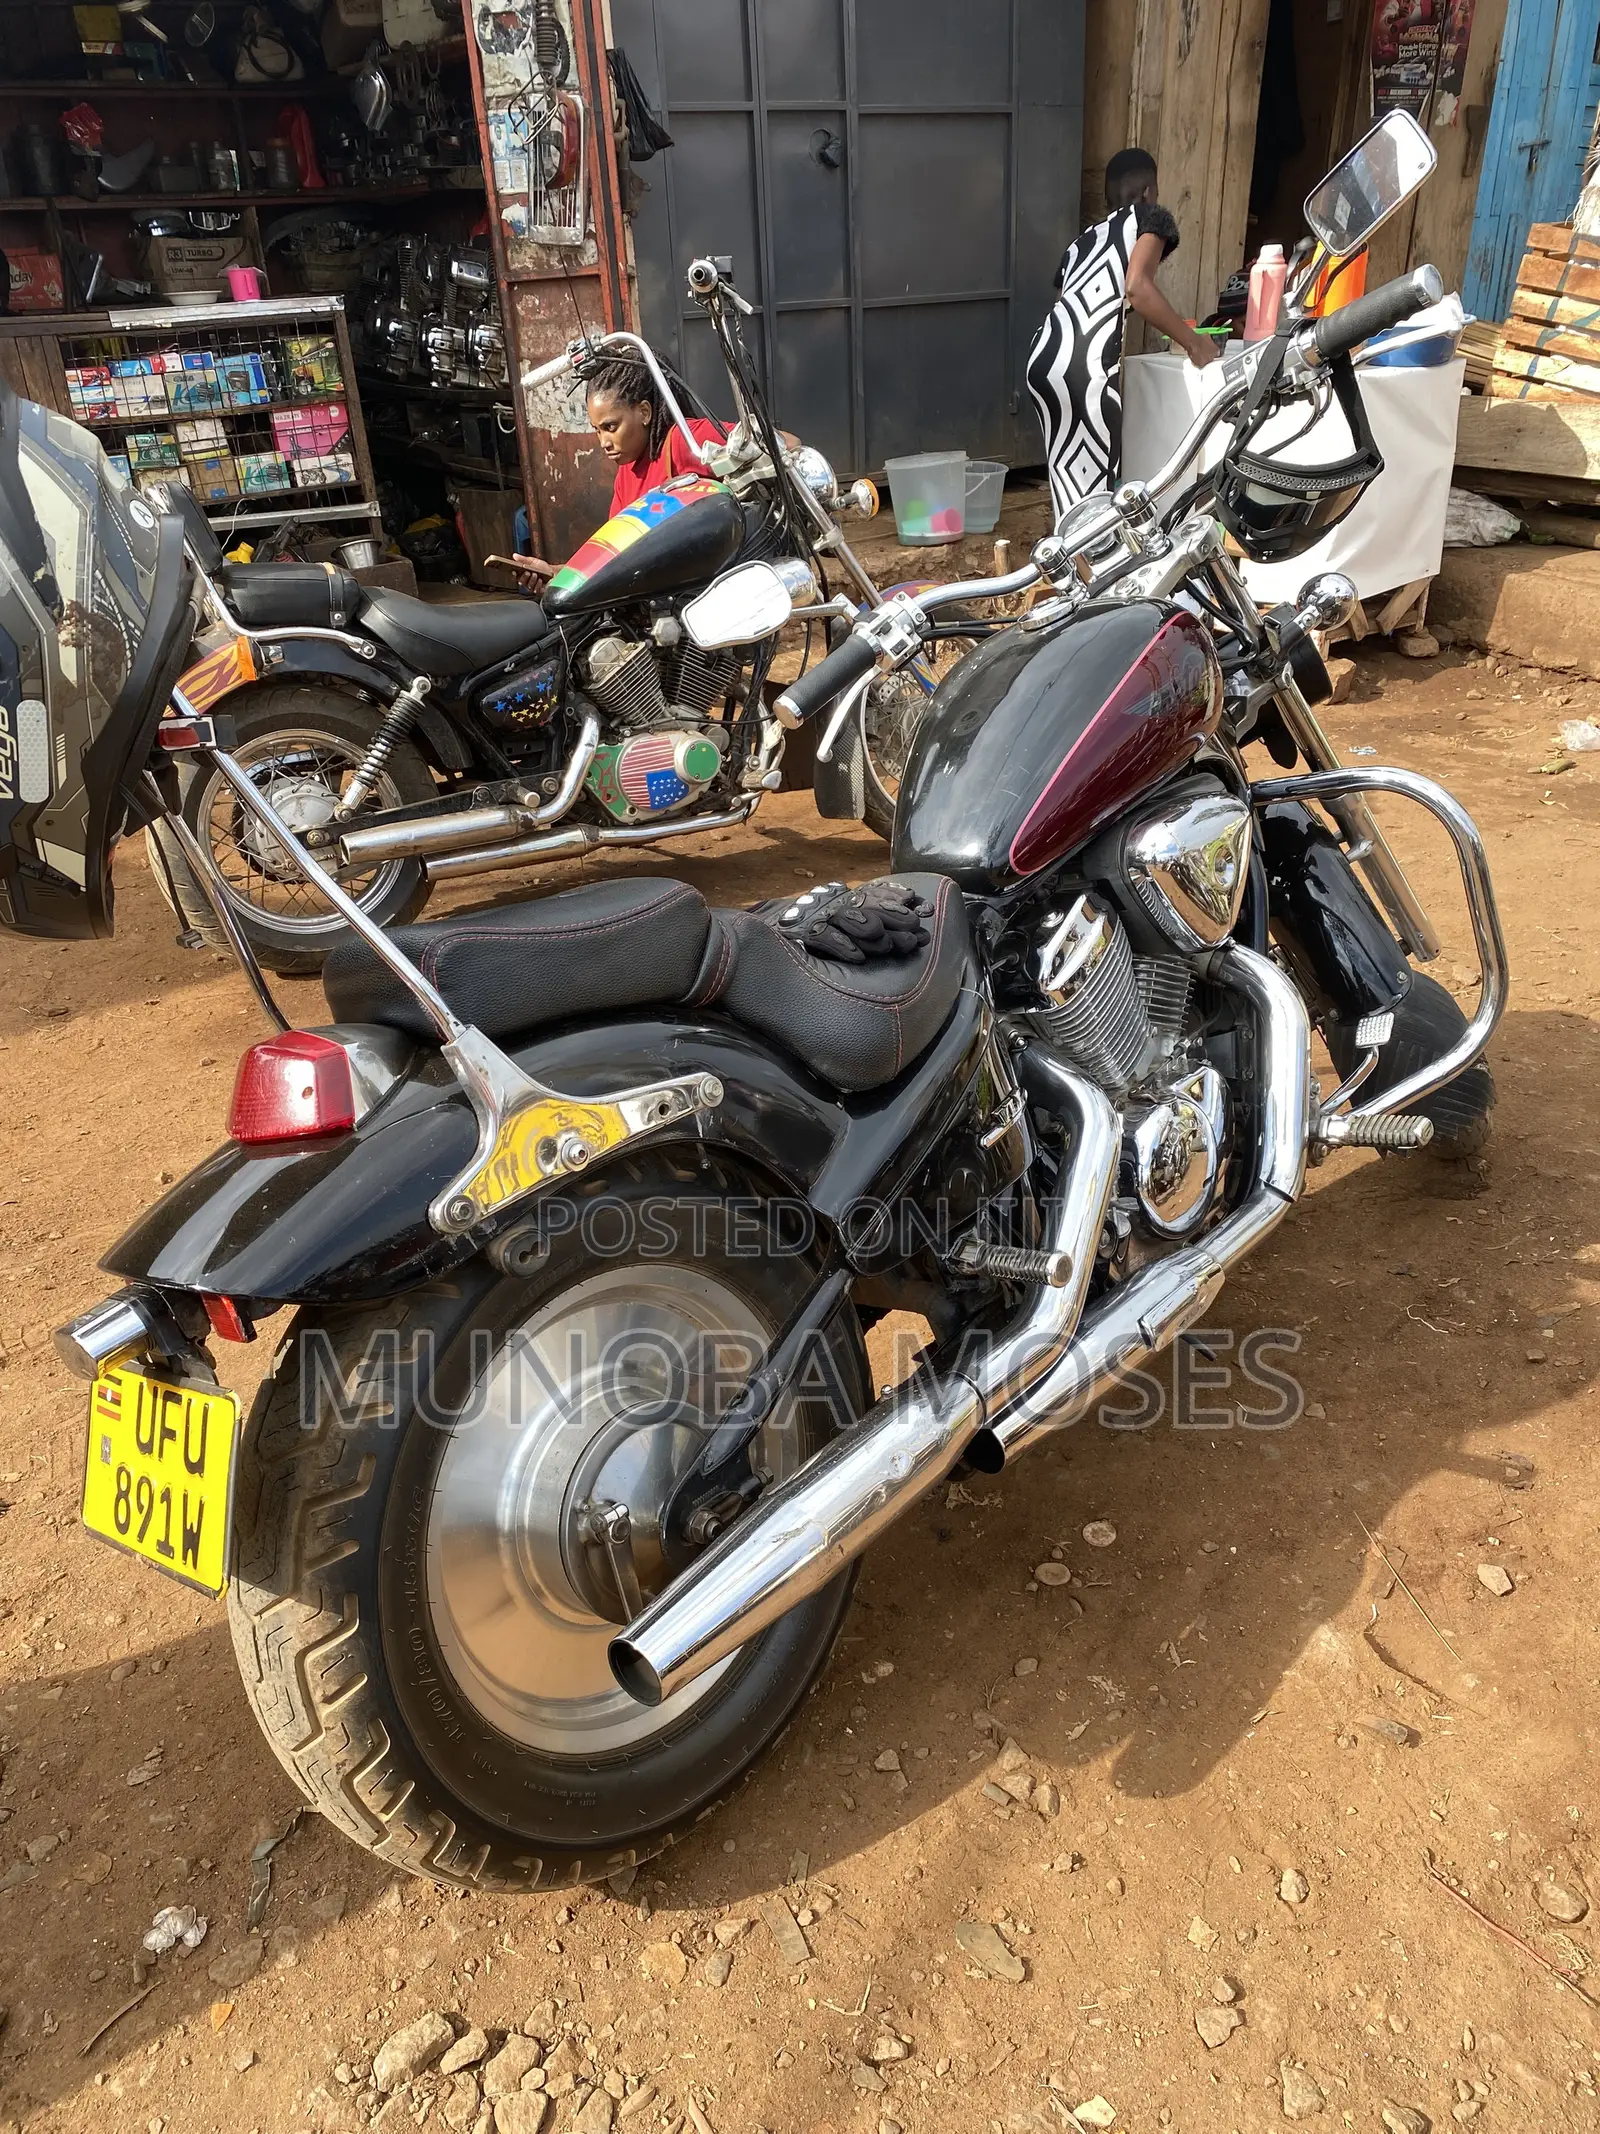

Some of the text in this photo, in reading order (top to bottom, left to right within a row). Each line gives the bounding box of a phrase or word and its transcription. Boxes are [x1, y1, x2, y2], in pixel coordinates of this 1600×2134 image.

[1399, 42, 1439, 51] Double Energy
[1399, 48, 1437, 59] More Wins
[167, 247, 213, 261] R3 TURBO
[135, 1381, 209, 1478] UFU
[114, 1464, 206, 1570] 891W
